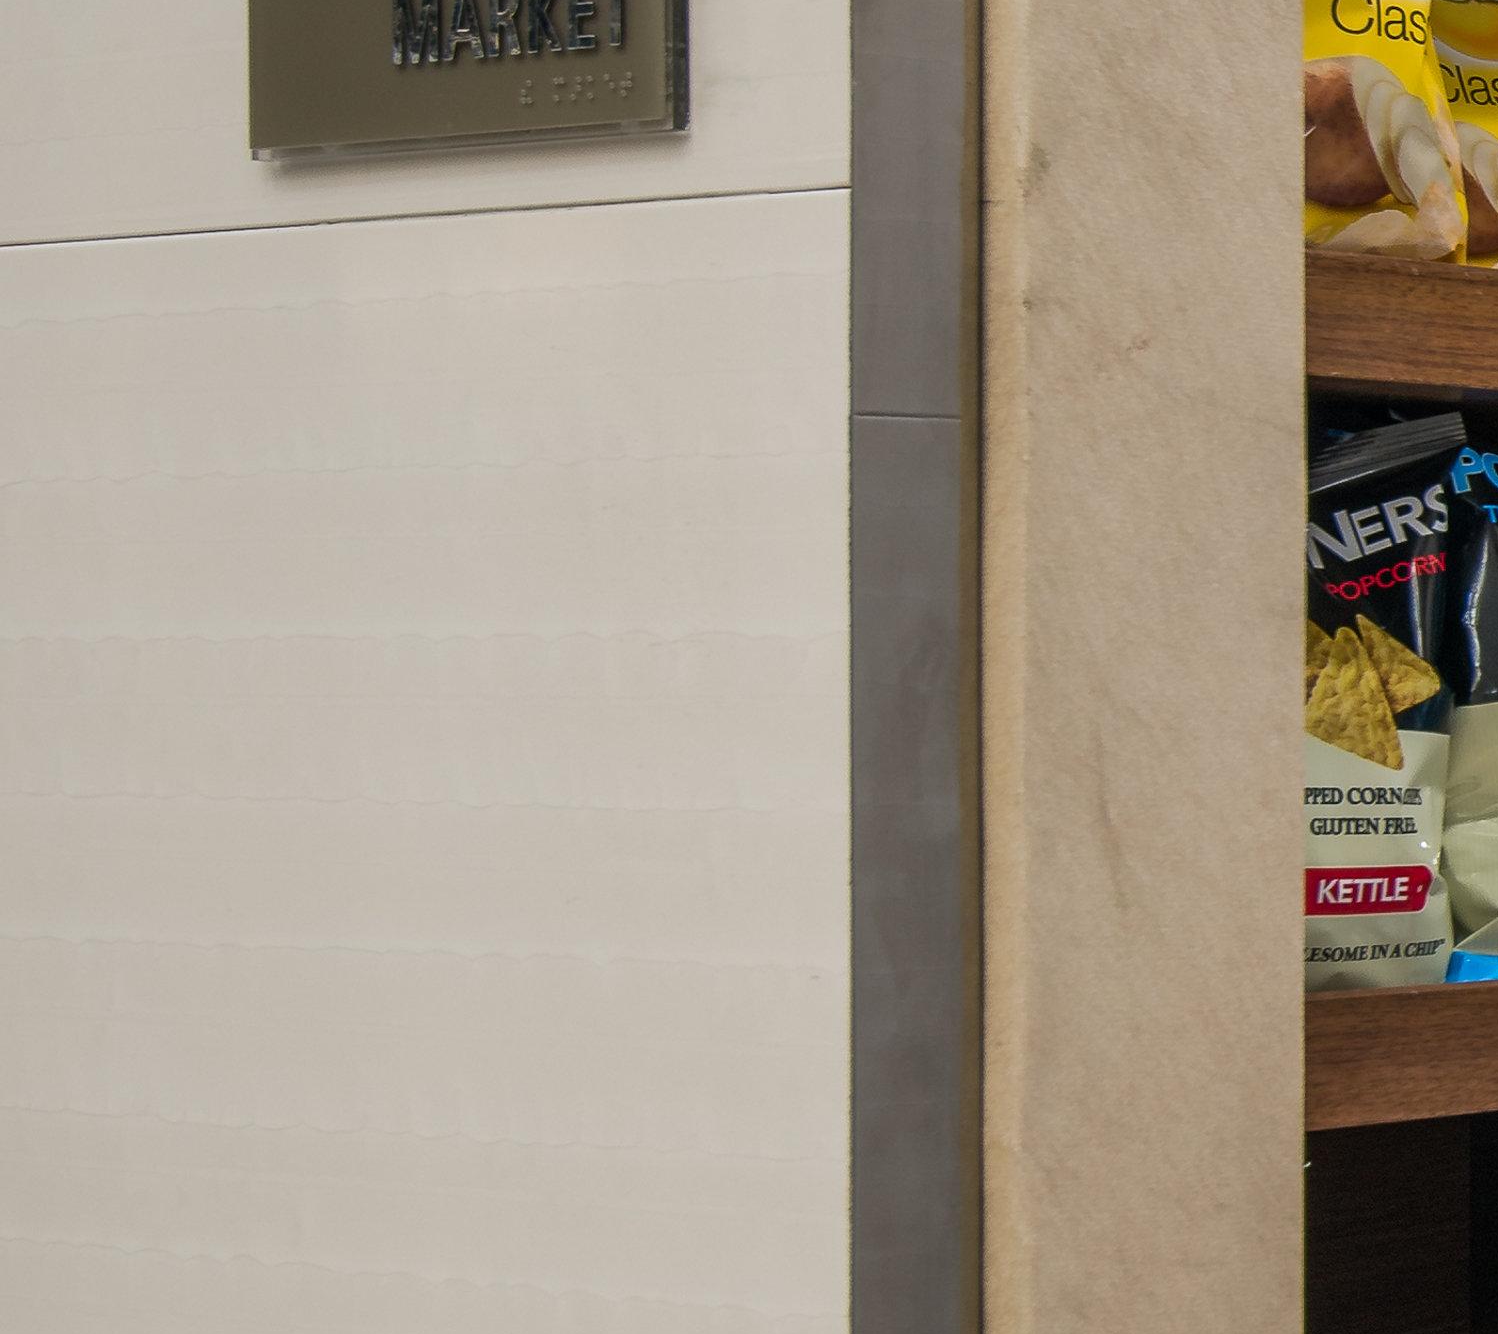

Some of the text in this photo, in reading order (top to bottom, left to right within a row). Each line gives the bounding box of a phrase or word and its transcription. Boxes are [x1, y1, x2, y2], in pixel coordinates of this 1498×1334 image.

[1347, 786, 1403, 806] CORN
[1309, 816, 1381, 836] GLUTEN
[1316, 876, 1410, 906] KETTLE
